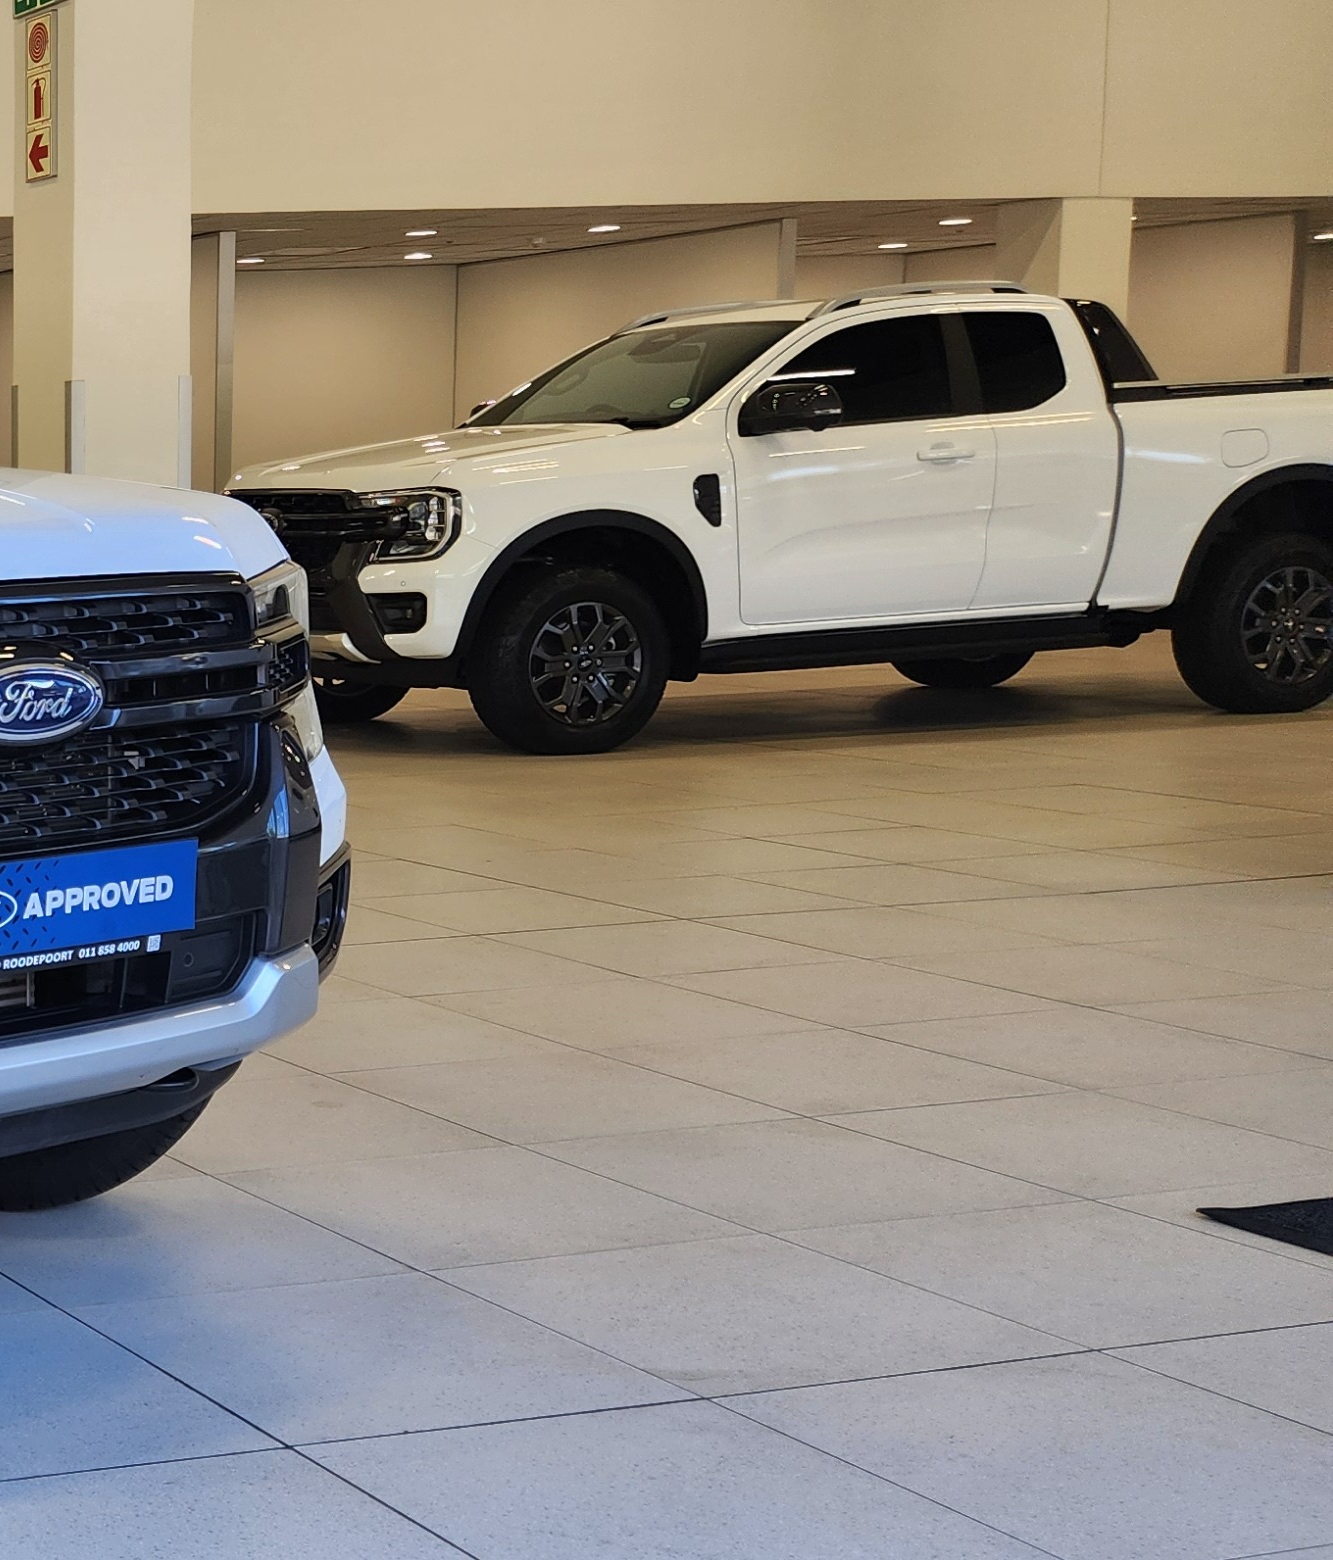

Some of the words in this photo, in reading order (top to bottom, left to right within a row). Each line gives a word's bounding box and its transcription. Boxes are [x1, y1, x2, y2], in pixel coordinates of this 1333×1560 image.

[22, 874, 174, 920] APPROVED
[2, 950, 73, 970] ROODEPOORT
[78, 948, 96, 960] 011
[97, 945, 116, 957] 858
[117, 940, 141, 953] 4000
